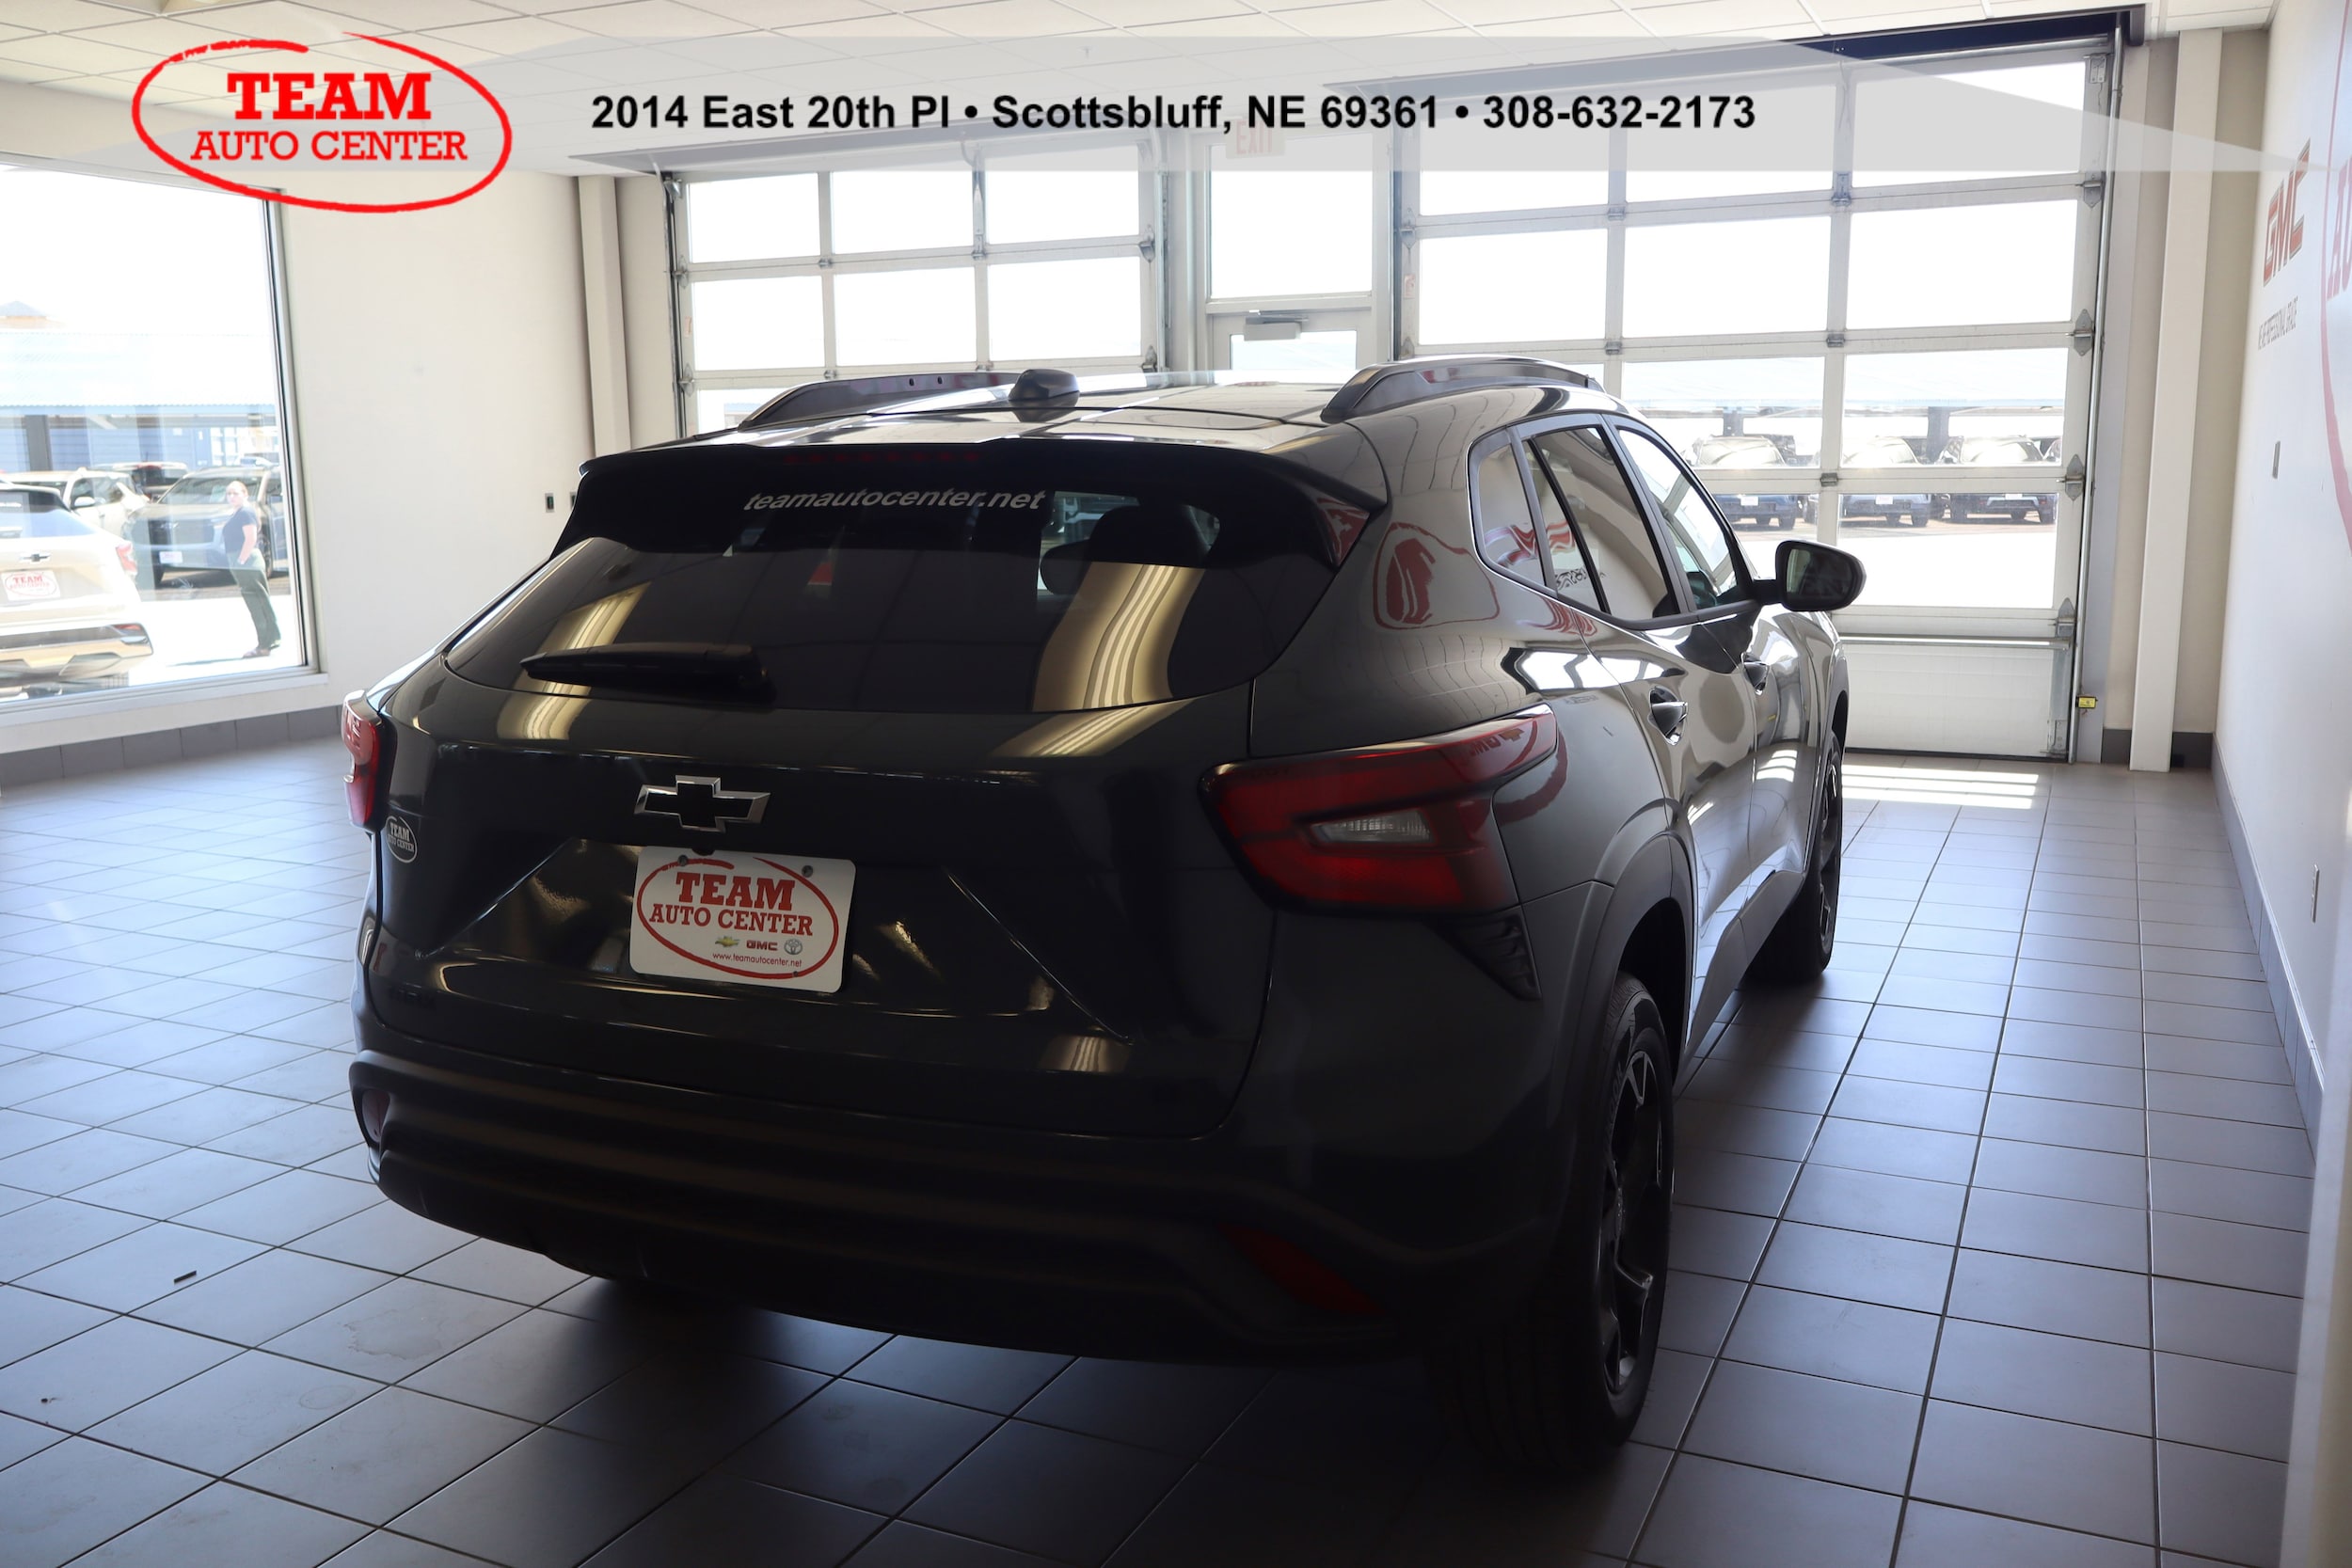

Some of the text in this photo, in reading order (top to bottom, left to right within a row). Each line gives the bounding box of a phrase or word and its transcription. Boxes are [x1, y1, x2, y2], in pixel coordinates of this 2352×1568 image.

[2263, 136, 2312, 288] GMC
[743, 487, 1046, 511] teamautocenter.net
[389, 821, 410, 842] TEAM
[675, 871, 795, 911] TEAM
[649, 903, 813, 937] AUTO CENTER
[746, 940, 778, 951] GMC
[712, 952, 802, 968] www.teamautocenter.net
